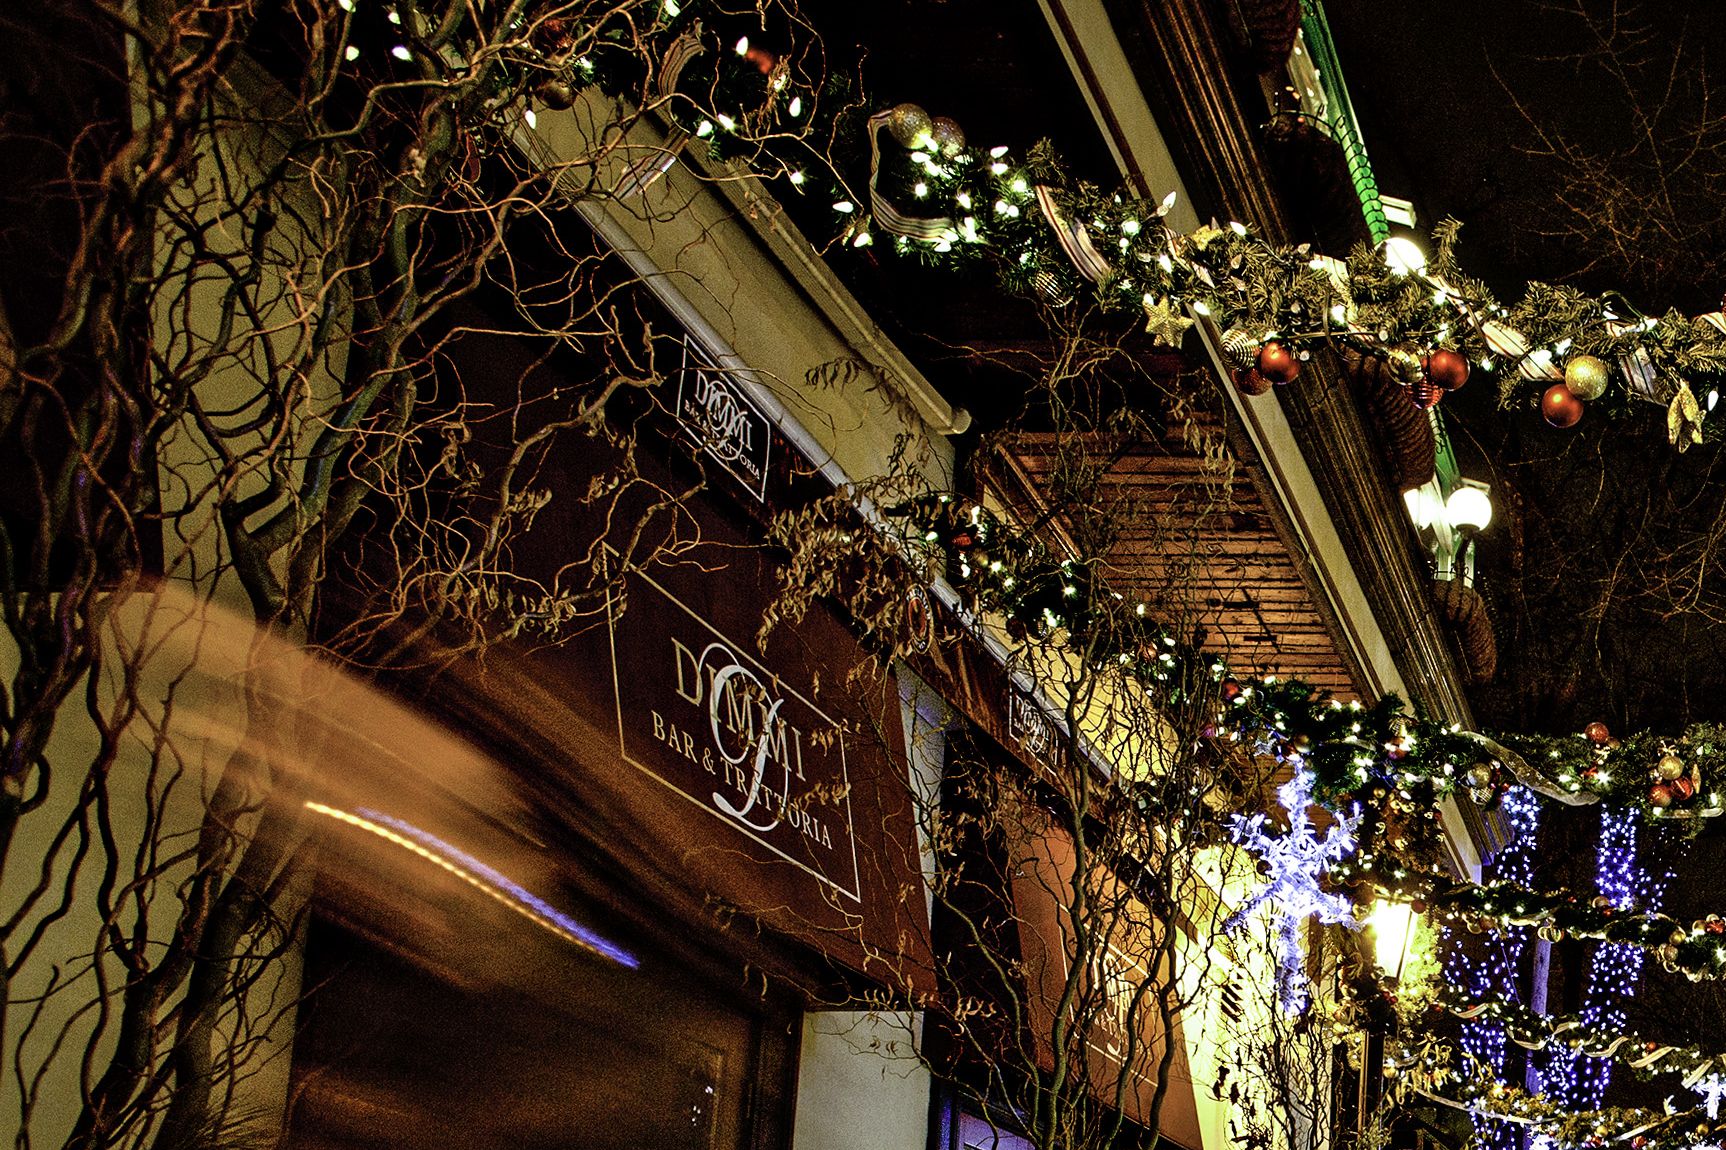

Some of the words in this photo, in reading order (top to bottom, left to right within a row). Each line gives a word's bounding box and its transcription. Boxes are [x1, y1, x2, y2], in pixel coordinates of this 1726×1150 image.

[695, 370, 753, 451] DIMMI
[651, 710, 698, 763] BAR
[702, 747, 717, 775] &
[671, 637, 806, 782] DIMMI
